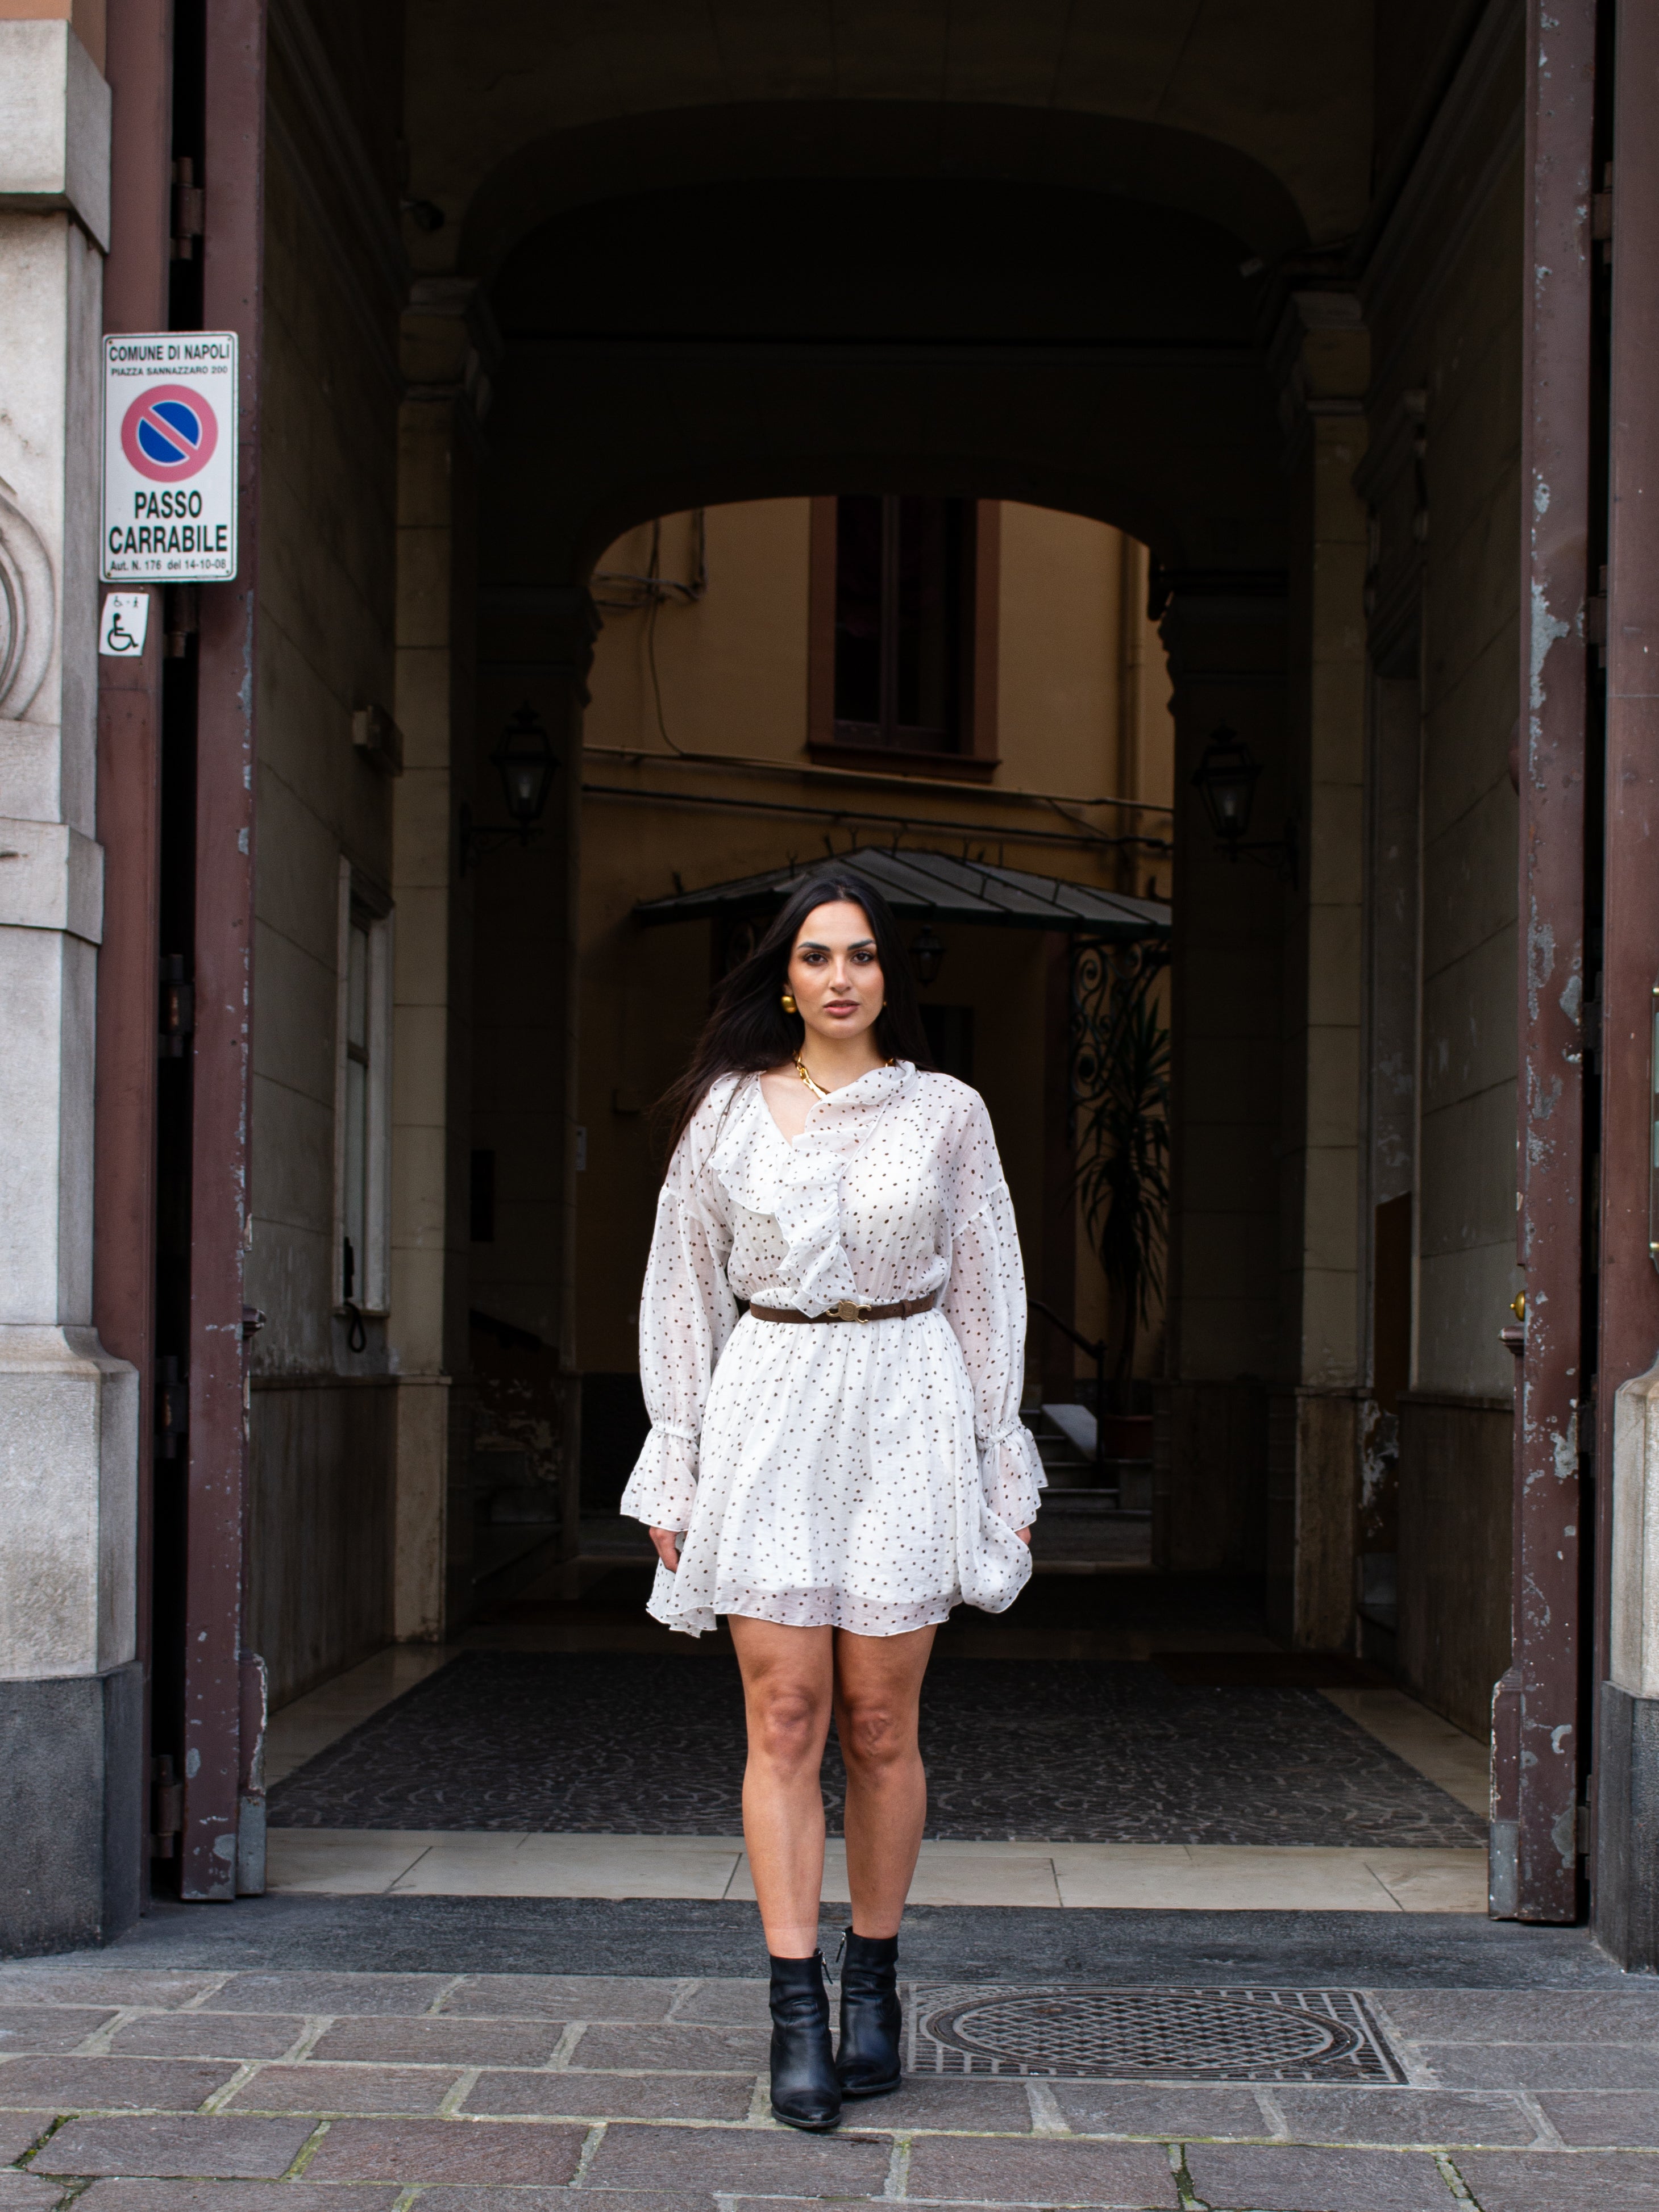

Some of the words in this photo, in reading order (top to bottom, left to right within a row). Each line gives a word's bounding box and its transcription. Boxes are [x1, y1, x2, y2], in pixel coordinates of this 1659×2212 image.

[109, 346, 164, 361] COMUNE
[168, 345, 180, 360] DI
[185, 344, 229, 359] NAPOLI
[147, 366, 208, 375] SANNAZZARO
[135, 490, 202, 519] PASSO
[109, 525, 227, 554] CARRABILE
[110, 561, 128, 571] Aut.
[132, 560, 141, 570] N.
[145, 560, 161, 569] 176
[167, 559, 181, 569] del
[185, 559, 226, 569] 14-10-08
